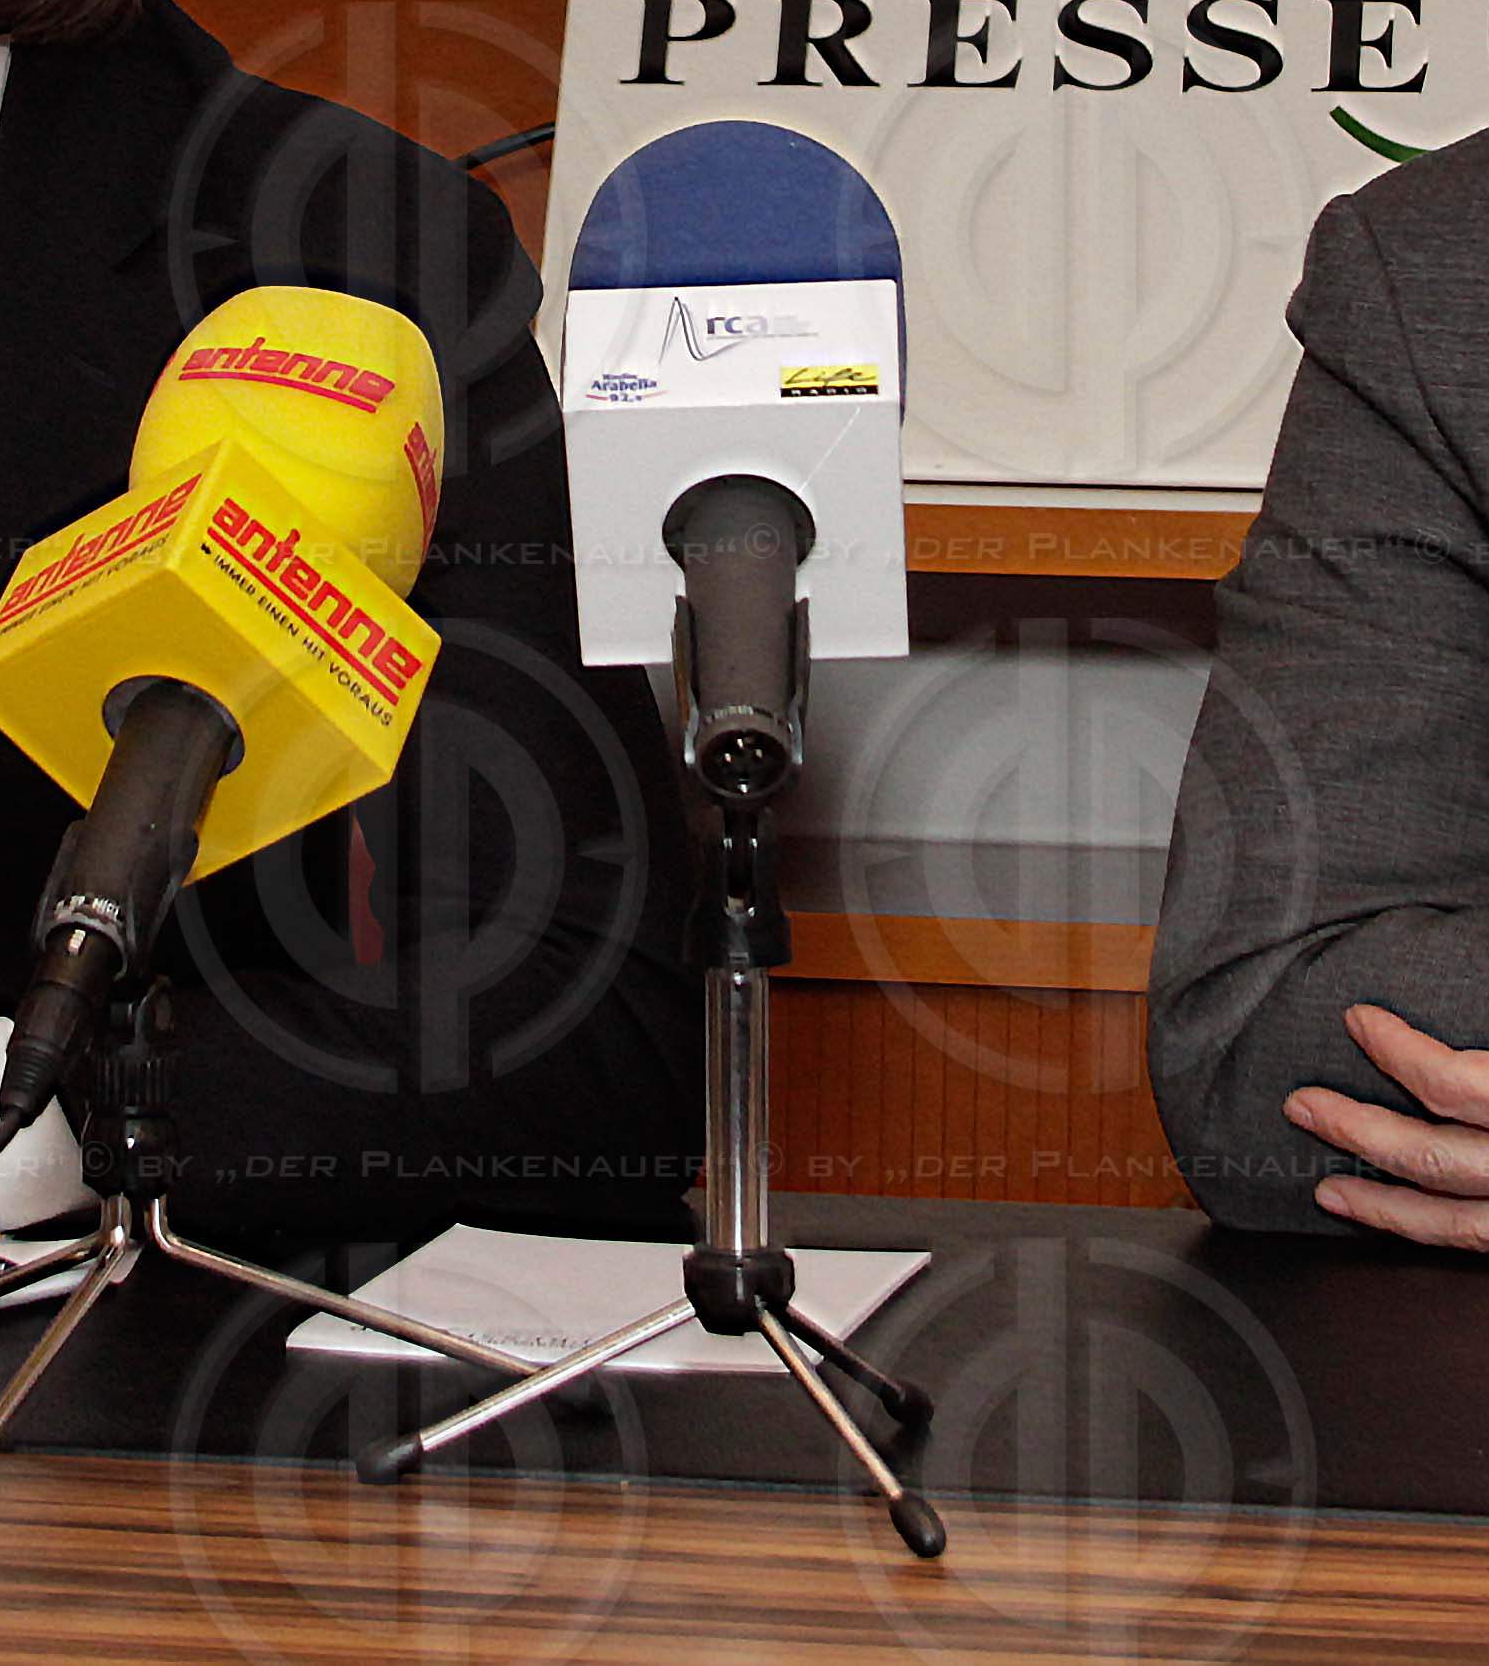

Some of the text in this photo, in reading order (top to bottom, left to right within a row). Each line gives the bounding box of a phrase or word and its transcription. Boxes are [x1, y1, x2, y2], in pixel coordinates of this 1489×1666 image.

[181, 337, 395, 403] antenne
[212, 497, 423, 691] antenne
[329, 660, 394, 727] VORAUS
